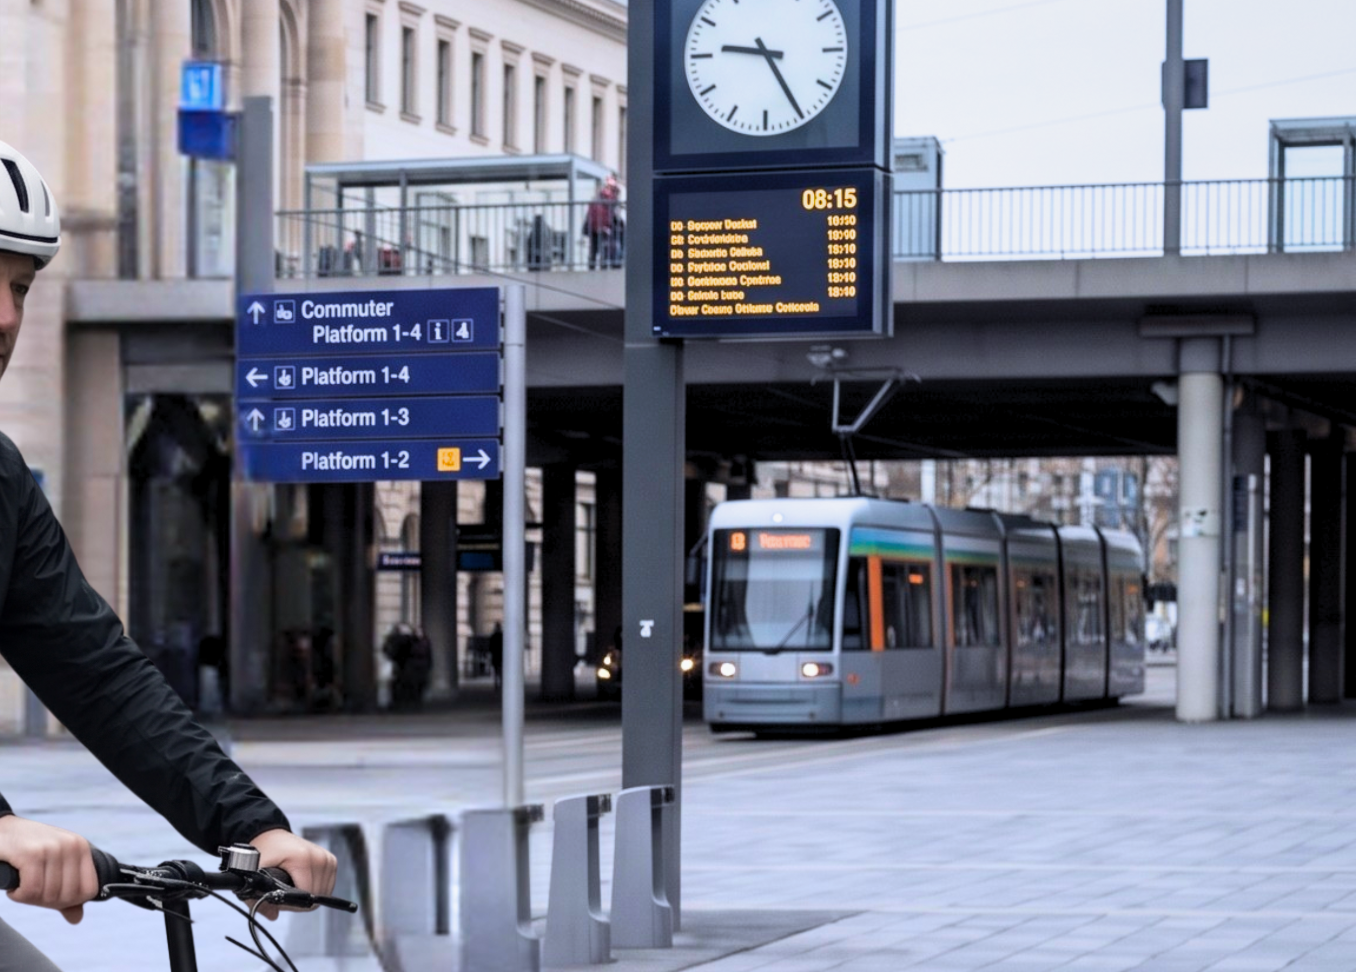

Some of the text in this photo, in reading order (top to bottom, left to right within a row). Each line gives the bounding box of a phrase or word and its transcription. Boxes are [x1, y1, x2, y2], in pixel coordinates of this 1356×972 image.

[802, 187, 857, 210] 08:15
[301, 299, 394, 319] Commuter
[313, 324, 387, 344] Platform
[393, 323, 422, 342] 1-4
[301, 366, 410, 385] Platform 1-4
[301, 407, 410, 427] Platform 1-3
[301, 450, 410, 470] Platform 1-2
